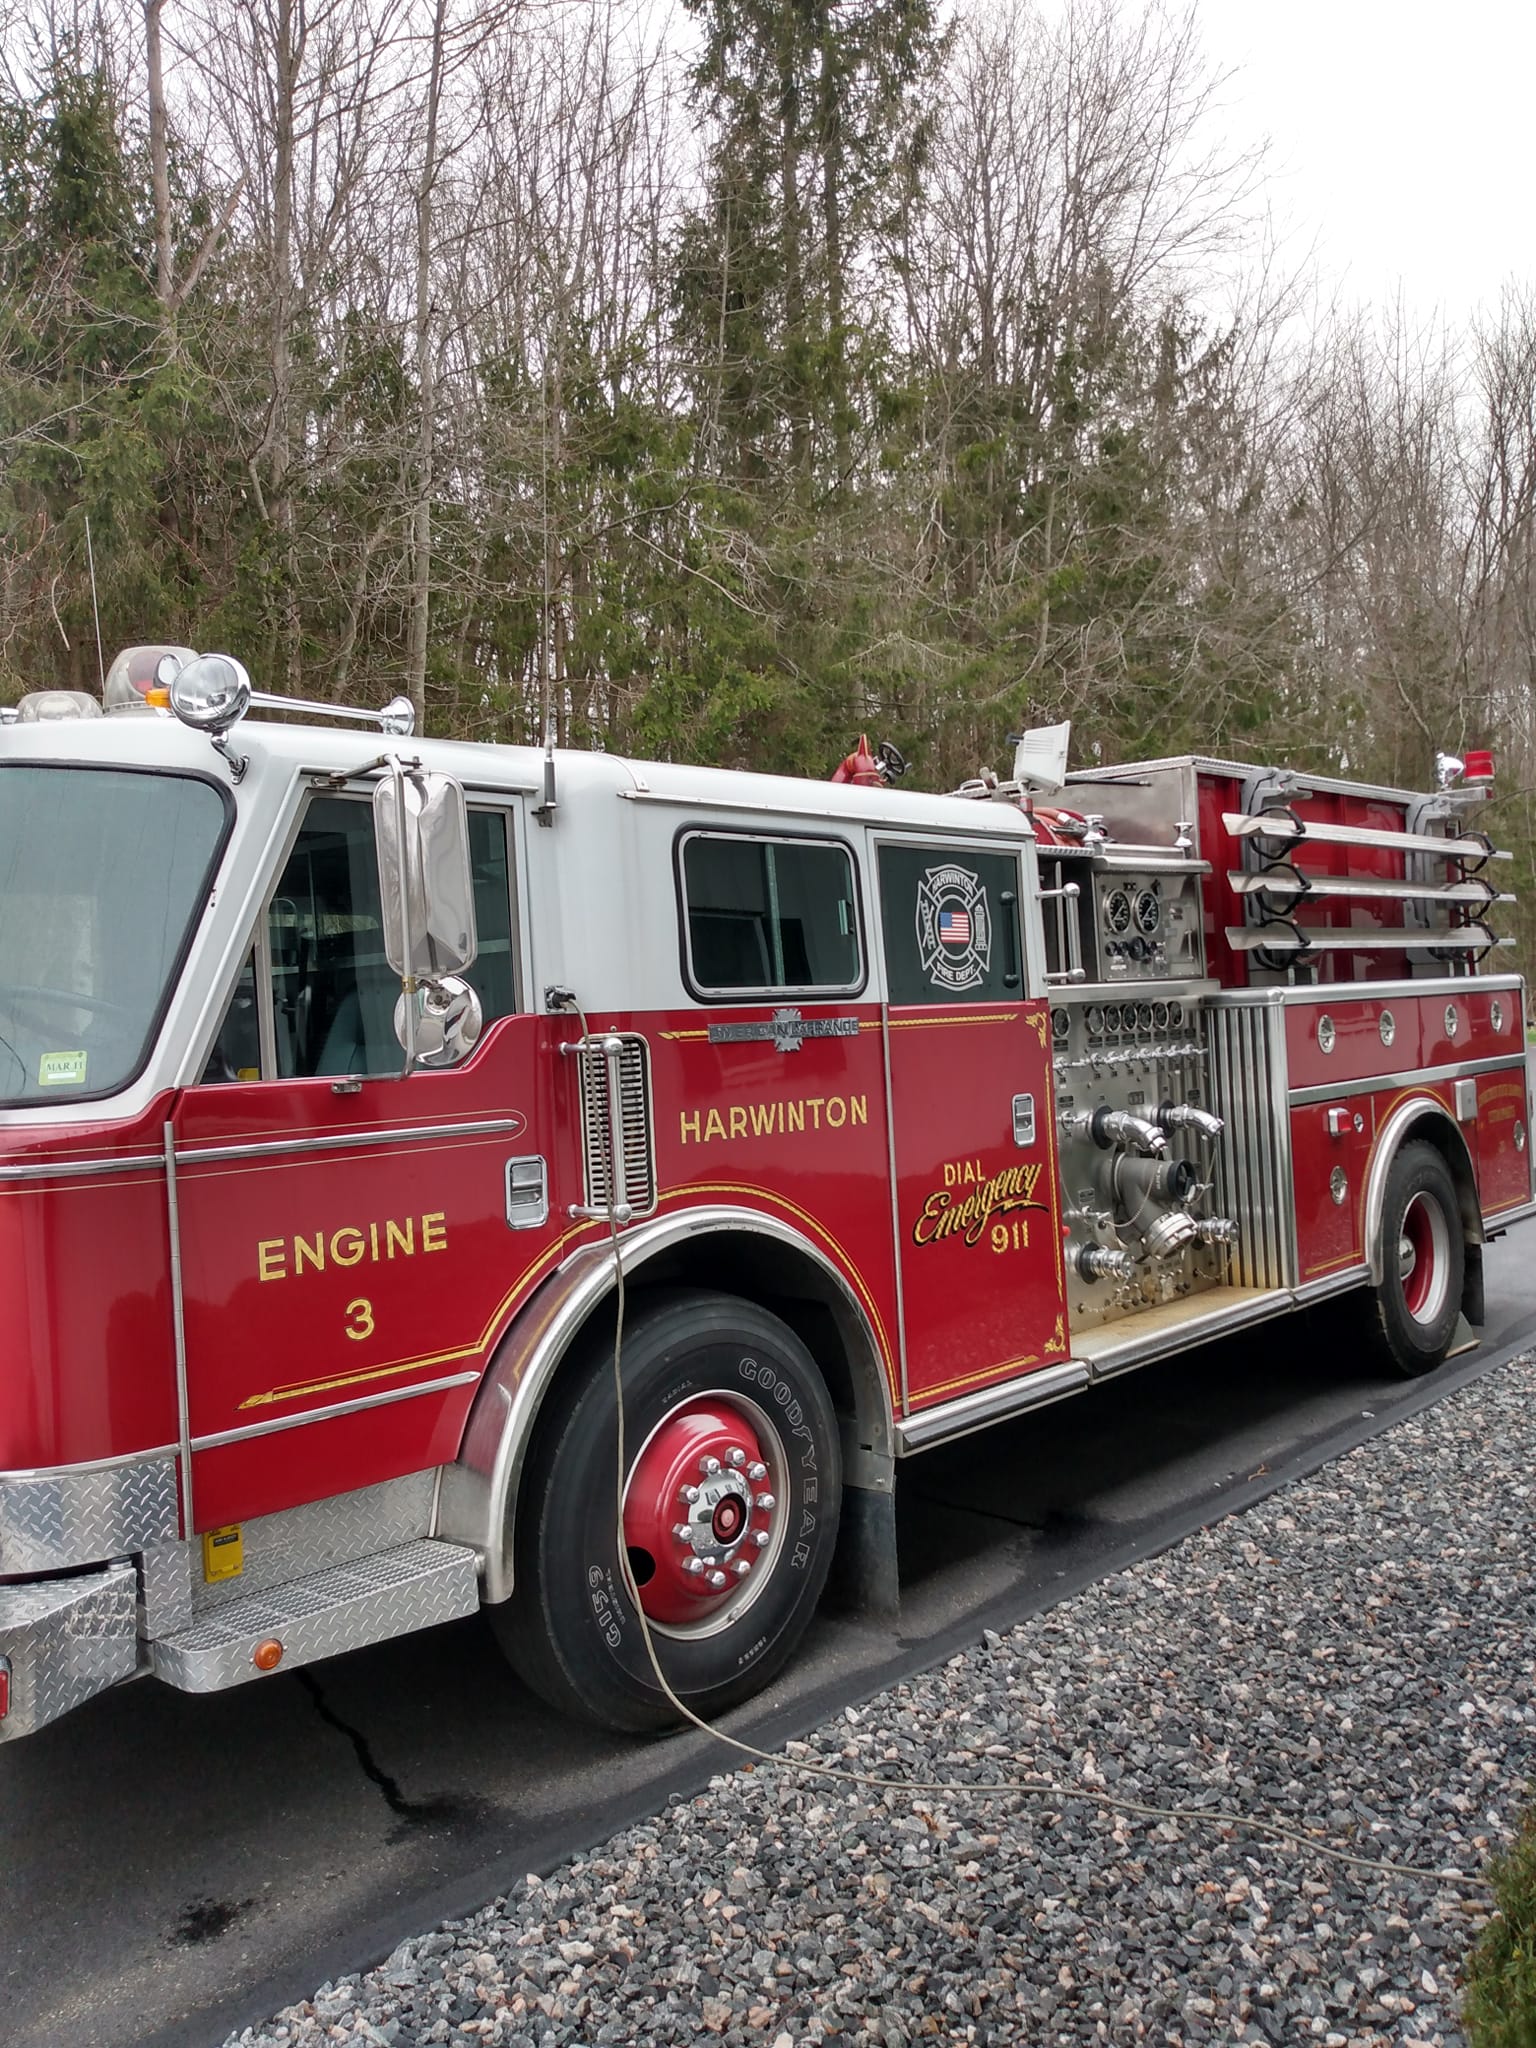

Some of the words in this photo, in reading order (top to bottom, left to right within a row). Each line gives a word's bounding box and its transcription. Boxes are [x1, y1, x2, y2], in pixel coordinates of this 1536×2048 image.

[932, 871, 974, 897] HARWINTON
[936, 961, 955, 981] FIRE
[47, 1062, 70, 1071] MAR
[679, 1094, 869, 1145] HARWINTON
[944, 1159, 986, 1187] DIAL
[913, 1163, 1046, 1247] Emergency
[257, 1211, 449, 1283] ENGINE
[991, 1219, 1029, 1254] 911
[344, 1297, 375, 1341] 3
[738, 1357, 818, 1569] GOODYEAR
[588, 1565, 622, 1648] G159
